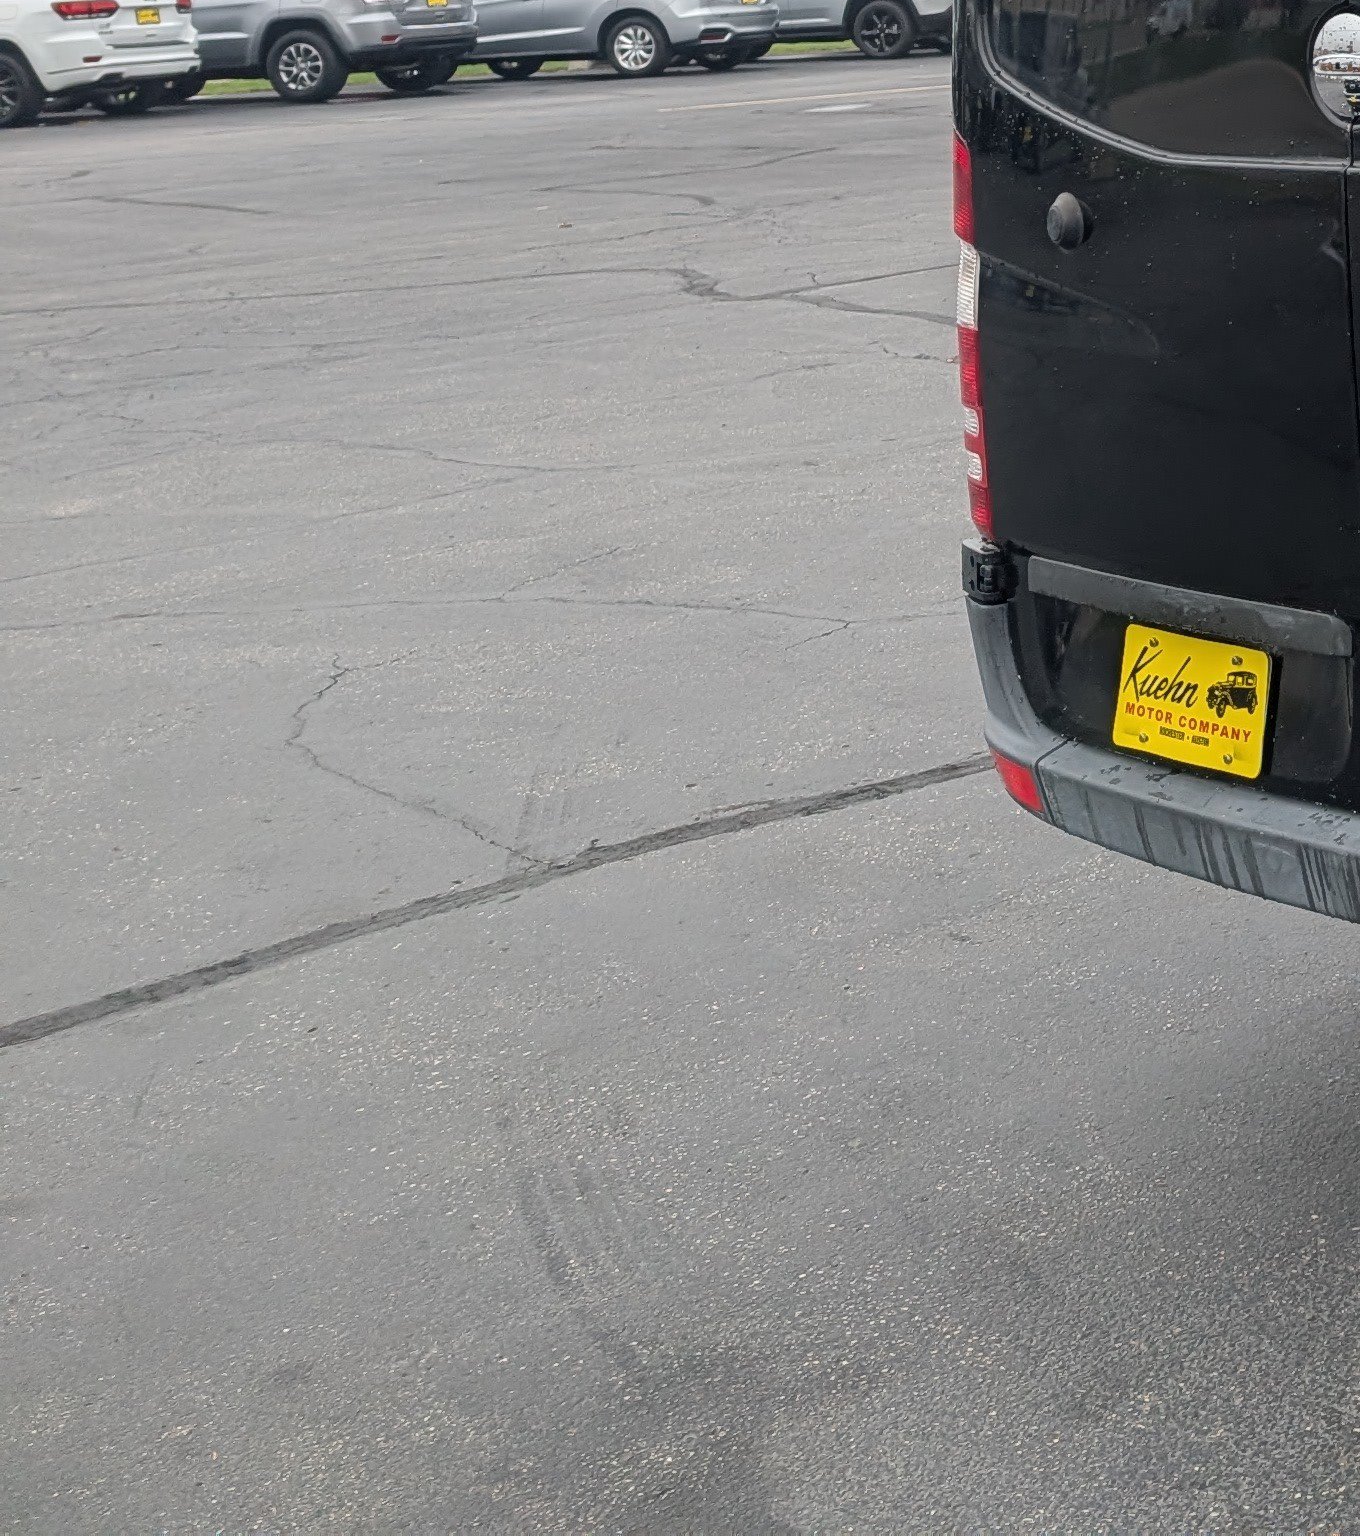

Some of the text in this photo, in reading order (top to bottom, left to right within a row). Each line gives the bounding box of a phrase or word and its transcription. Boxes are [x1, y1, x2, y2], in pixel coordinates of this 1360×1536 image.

[1123, 645, 1199, 708] Kuehn
[1124, 701, 1252, 742] MOTOR COMPANY
